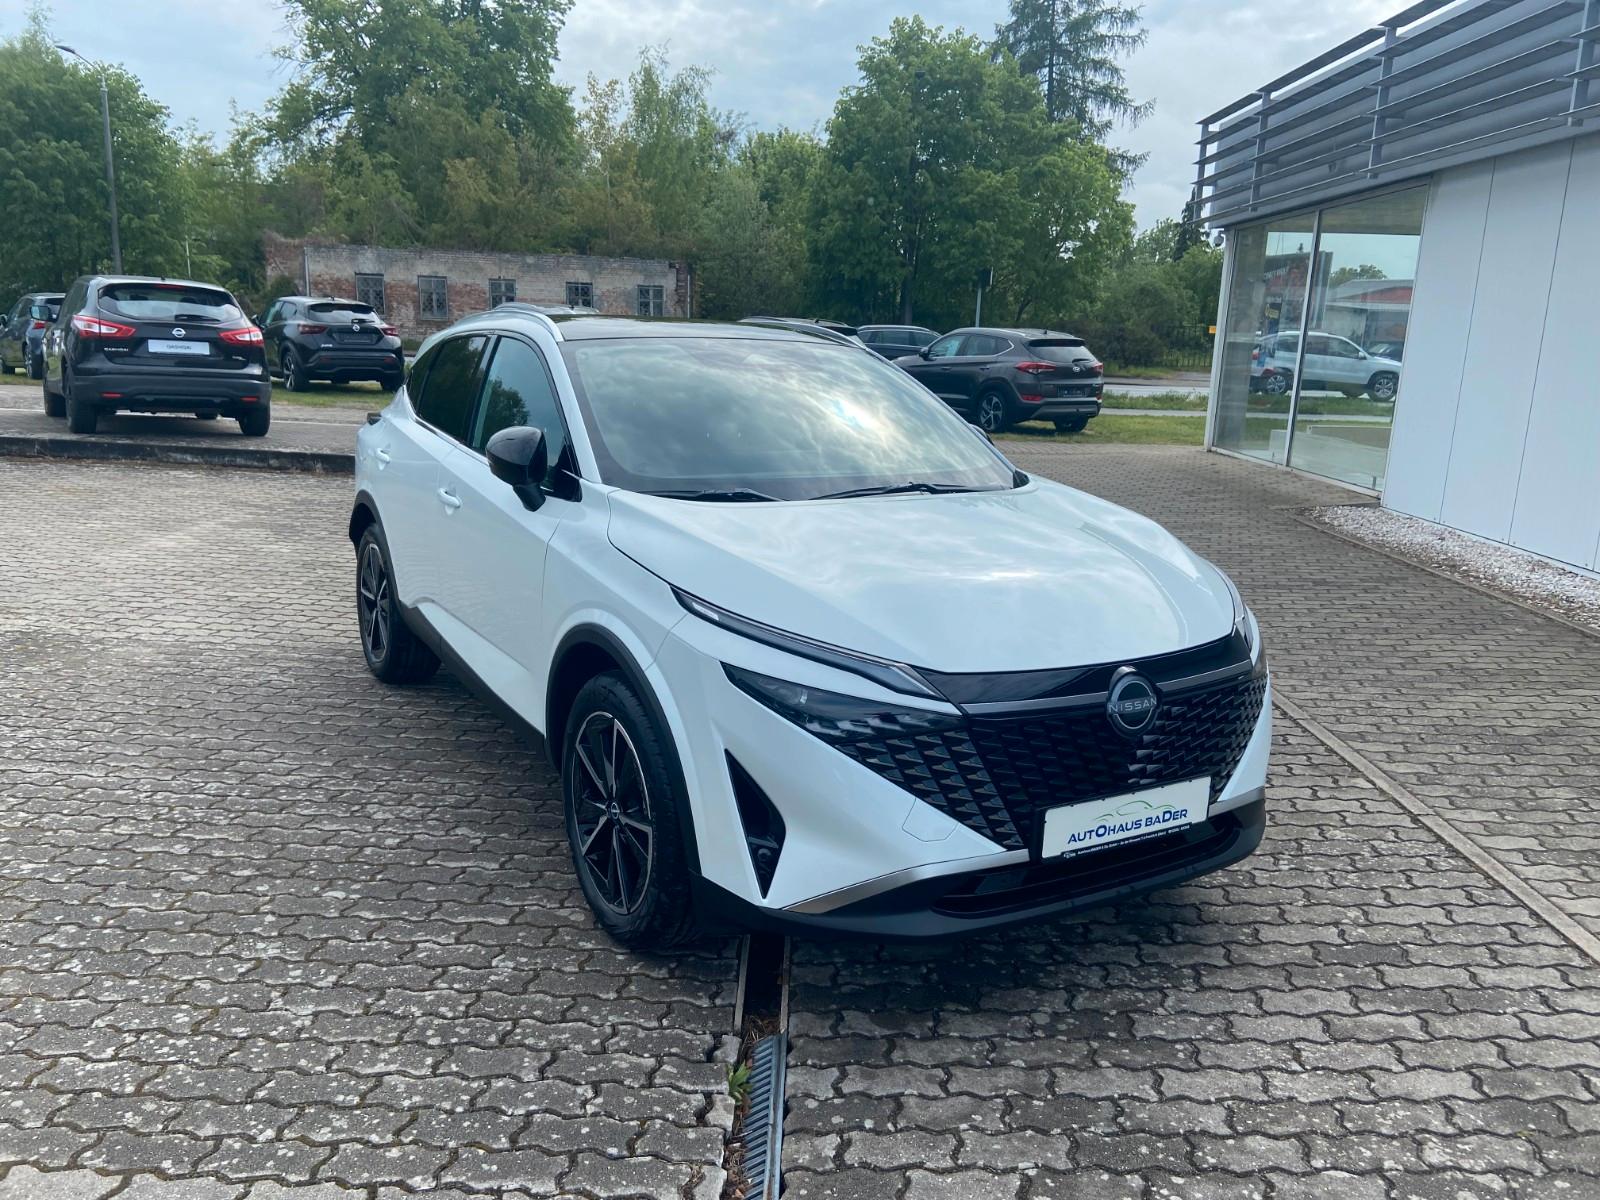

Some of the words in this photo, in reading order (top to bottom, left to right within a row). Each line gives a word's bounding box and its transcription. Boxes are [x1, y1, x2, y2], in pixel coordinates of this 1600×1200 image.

[1108, 697, 1157, 713] NISSAN
[1067, 819, 1143, 844] AUTOHAUS
[1144, 809, 1188, 827] BADER
